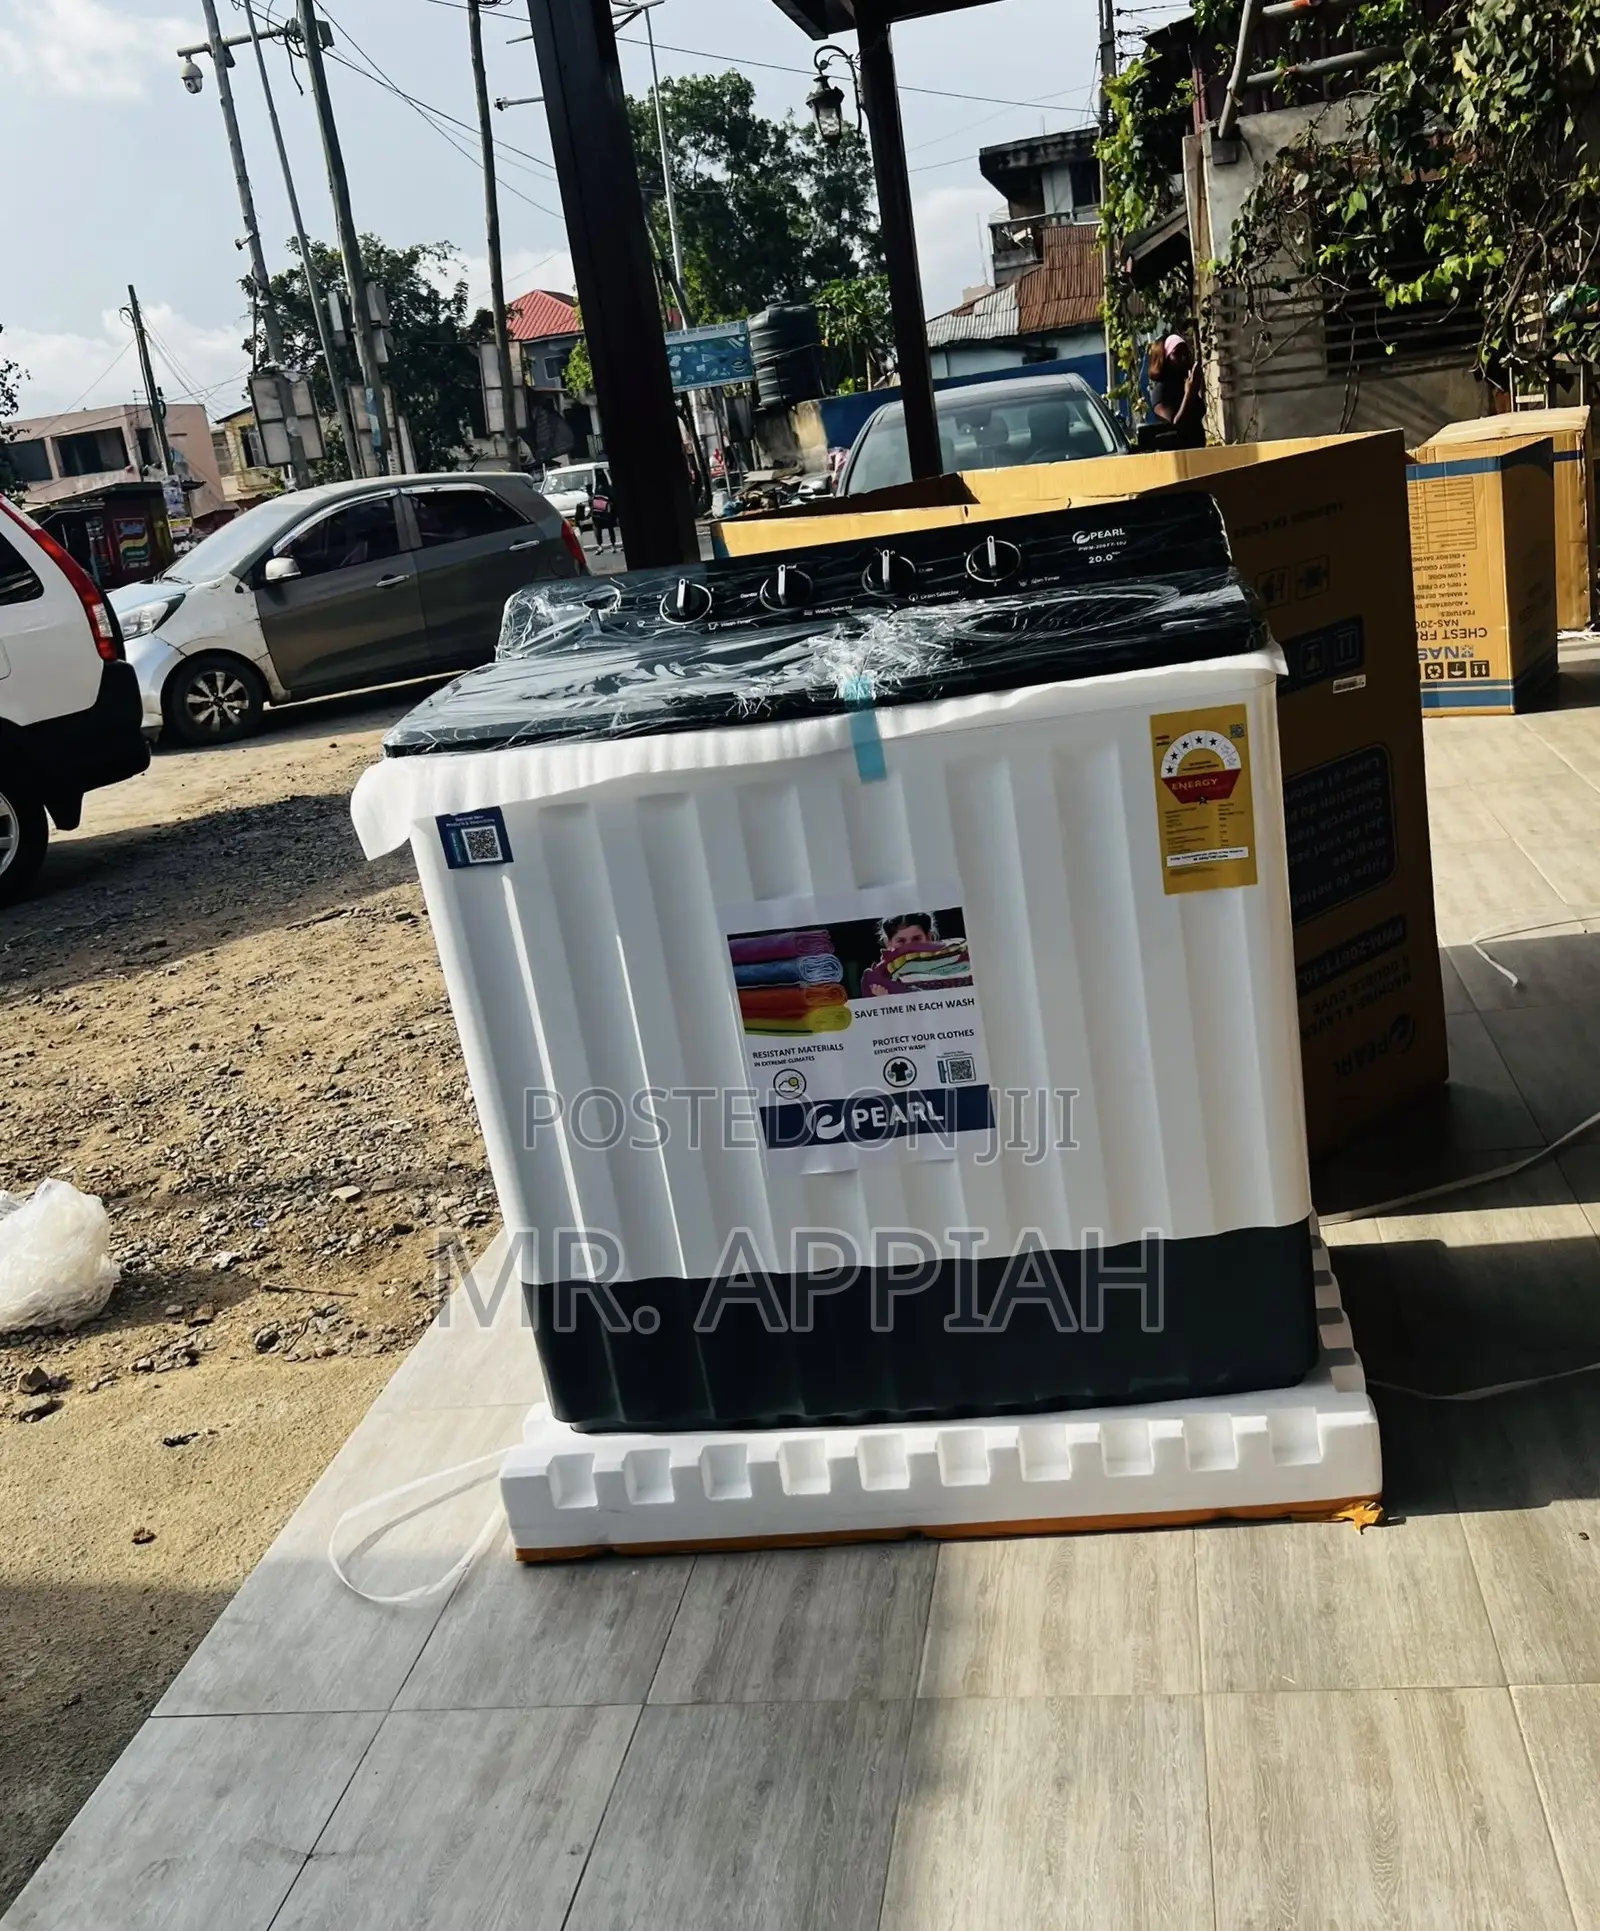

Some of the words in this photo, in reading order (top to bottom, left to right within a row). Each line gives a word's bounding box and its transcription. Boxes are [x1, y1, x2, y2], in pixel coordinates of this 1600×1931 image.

[1090, 528, 1126, 540] PEARL
[1442, 627, 1488, 640] CHEST
[1171, 778, 1218, 791] ENERGY
[854, 1008, 879, 1019] SAVE
[880, 1005, 904, 1016] TIME
[906, 1003, 917, 1013] IN
[918, 1001, 944, 1011] EACH
[945, 998, 975, 1008] WASH
[872, 1035, 910, 1047] PROTECT
[911, 1032, 936, 1042] YOUR
[937, 1029, 975, 1040] CLOTHES
[752, 1047, 797, 1059] RESISTANT
[797, 1043, 844, 1054] MATERIALS
[874, 1046, 907, 1055] EFFICIENTLY
[761, 1059, 787, 1067] EXTREME
[787, 1055, 815, 1064] CLIMATES
[852, 1101, 944, 1130] PEARL
